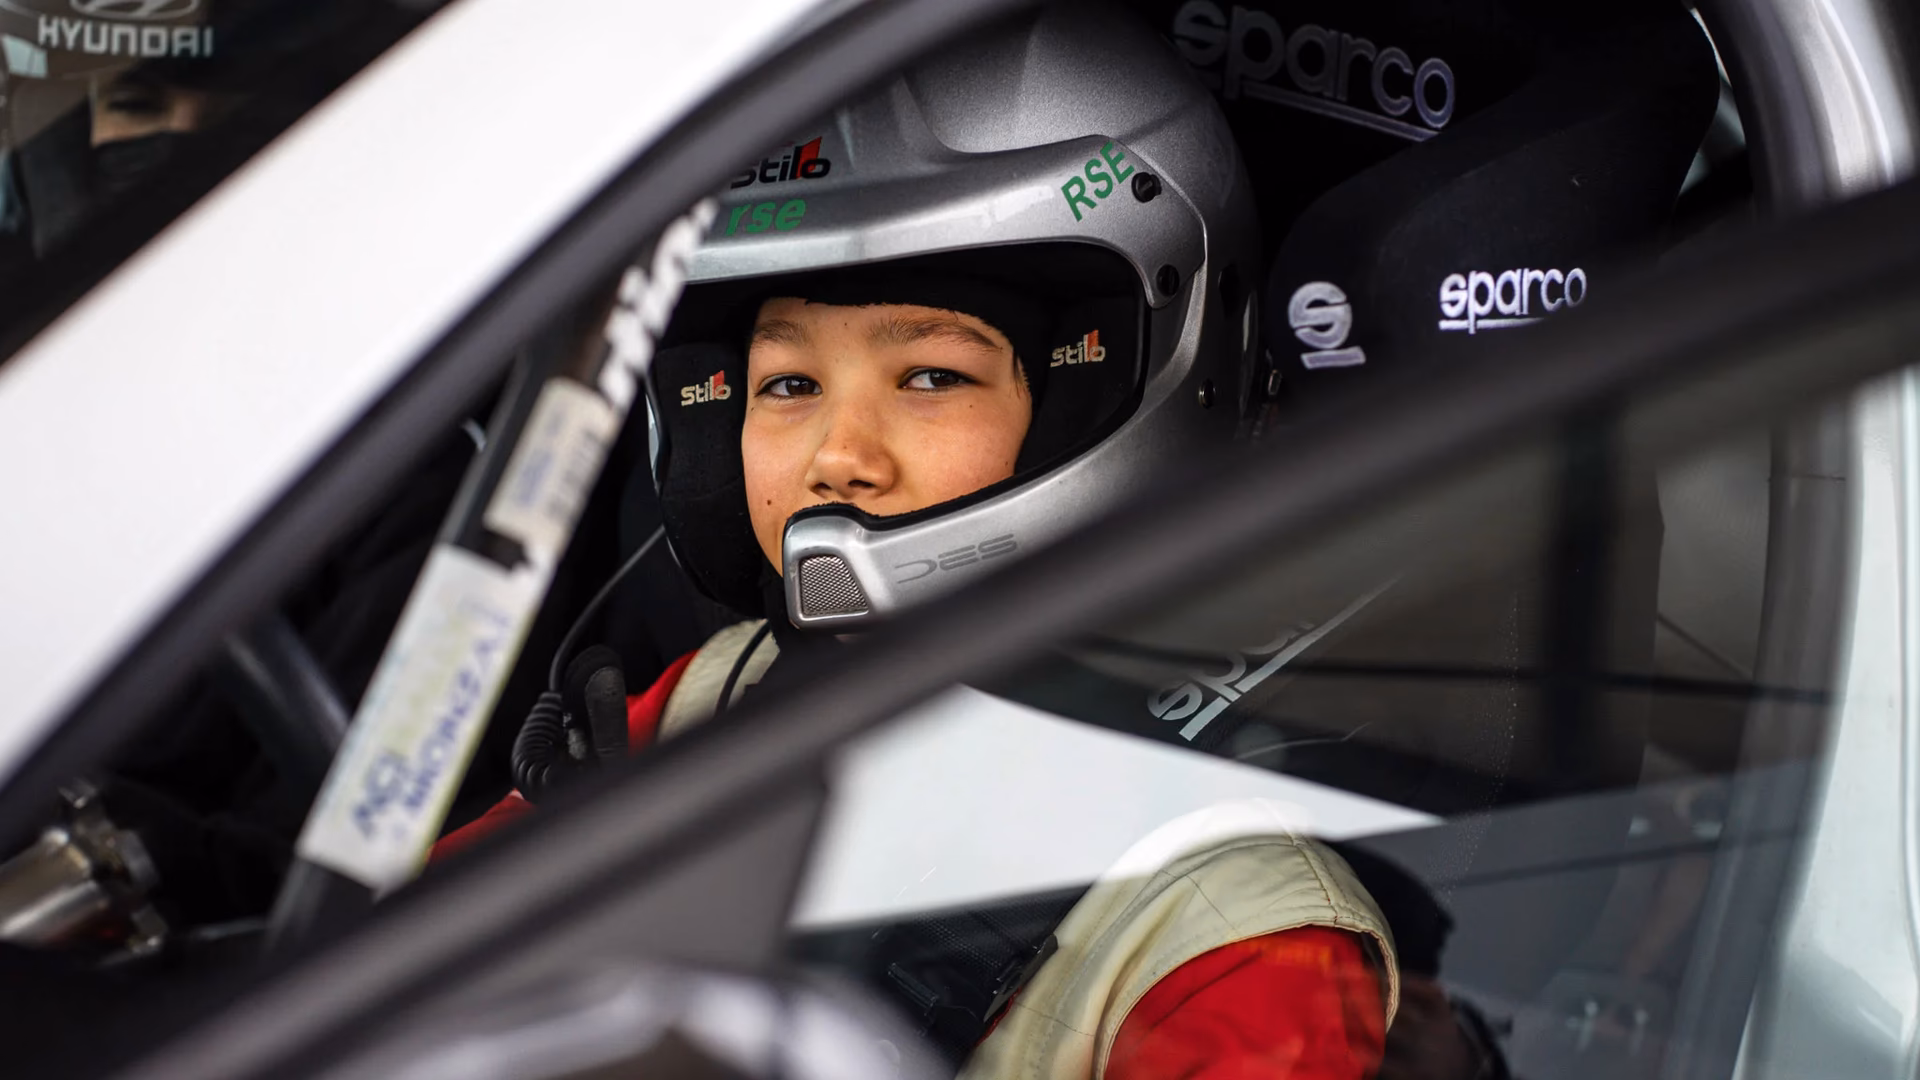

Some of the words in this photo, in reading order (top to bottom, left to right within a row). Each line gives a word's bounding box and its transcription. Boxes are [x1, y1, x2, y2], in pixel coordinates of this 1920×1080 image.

[38, 15, 214, 57] HYUNDAI
[1172, 0, 1455, 128] sparco
[1061, 140, 1135, 222] RSE
[725, 198, 807, 236] rse
[1439, 267, 1587, 334] sparco
